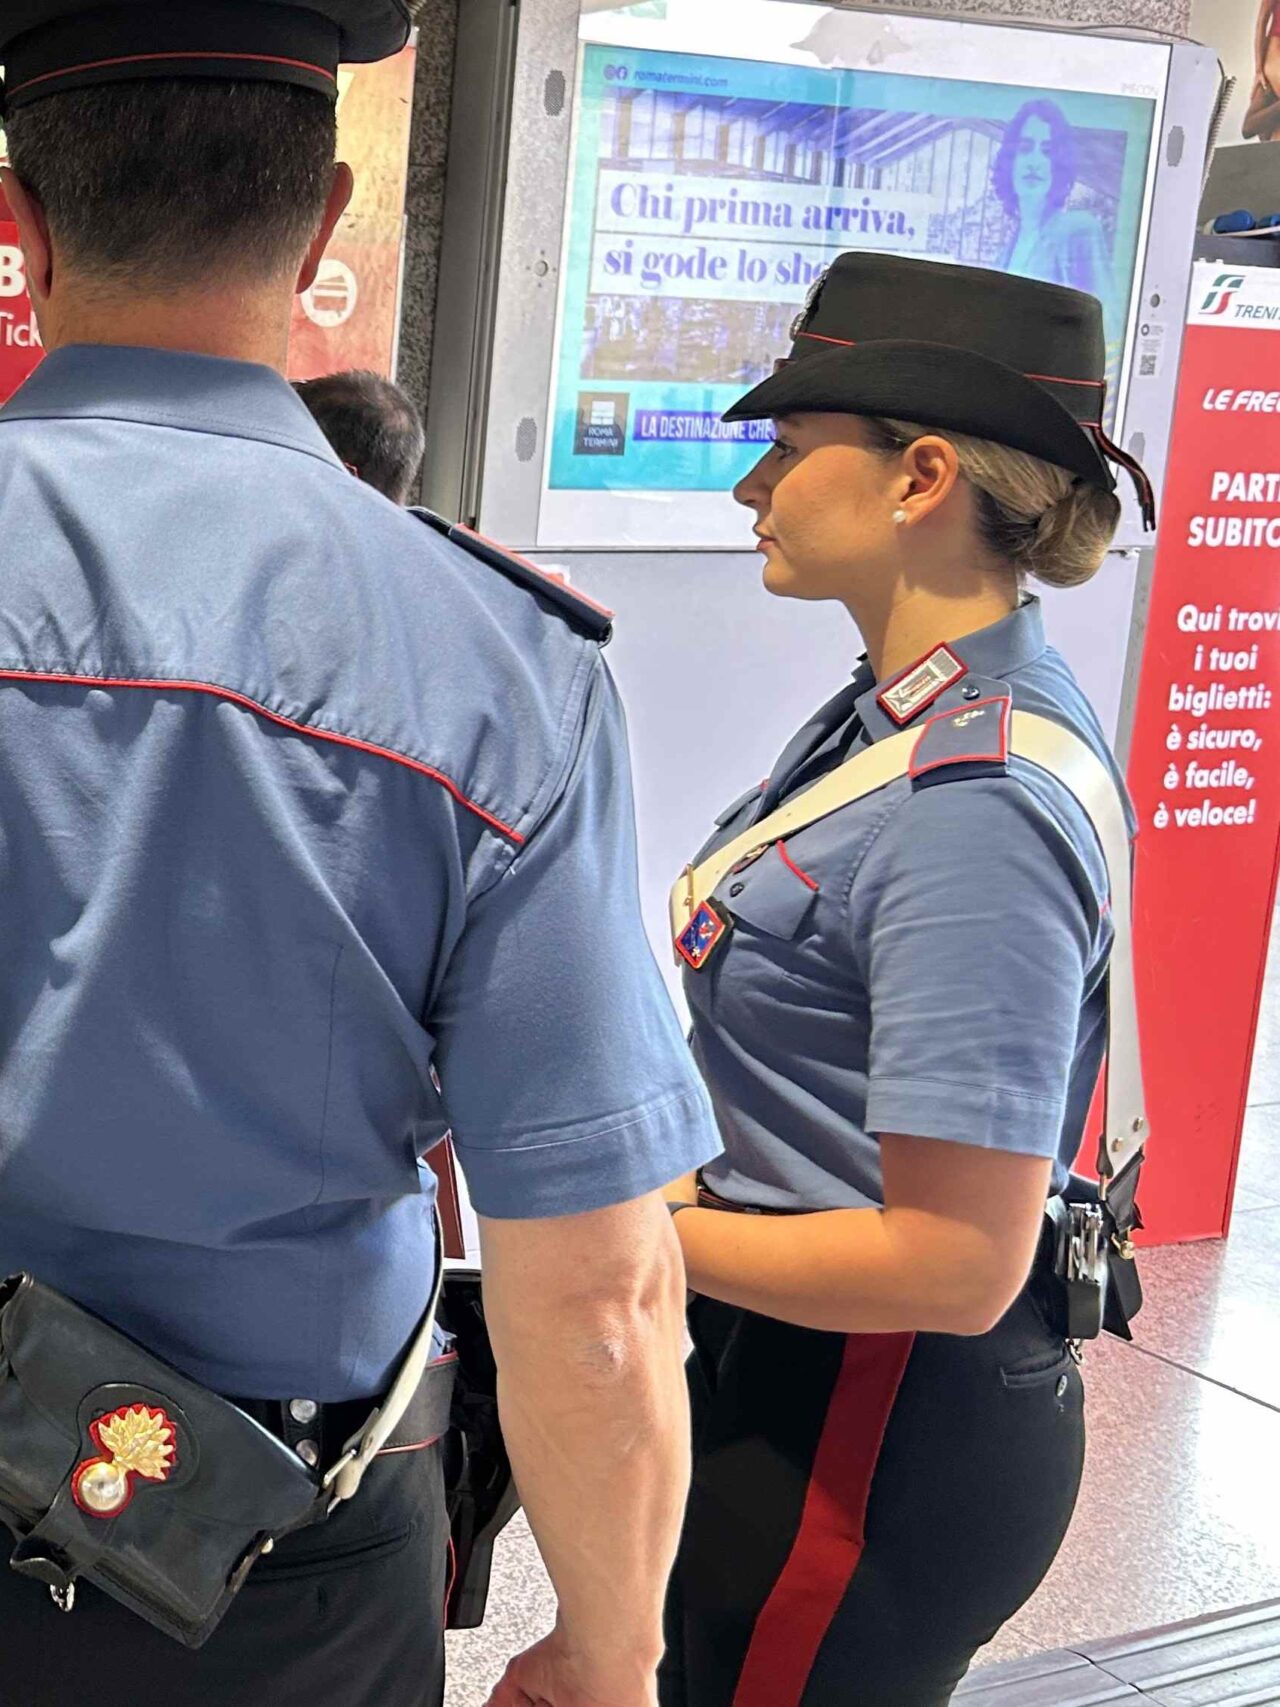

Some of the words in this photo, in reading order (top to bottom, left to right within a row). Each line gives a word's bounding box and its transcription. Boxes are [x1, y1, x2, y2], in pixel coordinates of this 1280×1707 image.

[634, 69, 729, 87] romatermini.com
[610, 182, 674, 220] Chi
[684, 187, 792, 234] prima
[802, 197, 915, 238] arriva,
[604, 239, 634, 275] si
[640, 246, 727, 289] gode
[737, 249, 767, 282] lo
[1235, 304, 1280, 320] TRENI
[1202, 389, 1234, 411] LE
[1231, 390, 1280, 413] FRE
[641, 416, 657, 437] LA
[660, 417, 745, 439] DESTINAZIONE
[1211, 471, 1280, 502] PART
[1177, 604, 1222, 632] Qui
[1194, 644, 1204, 671] i
[1209, 644, 1258, 671] tuoi
[1168, 682, 1272, 717] biglietti:
[1166, 723, 1182, 750] è
[1186, 723, 1262, 752] sicuro,
[1164, 762, 1179, 790] è
[1185, 760, 1255, 790] facile,
[1153, 801, 1169, 829] è
[1174, 799, 1256, 827] veloce!
